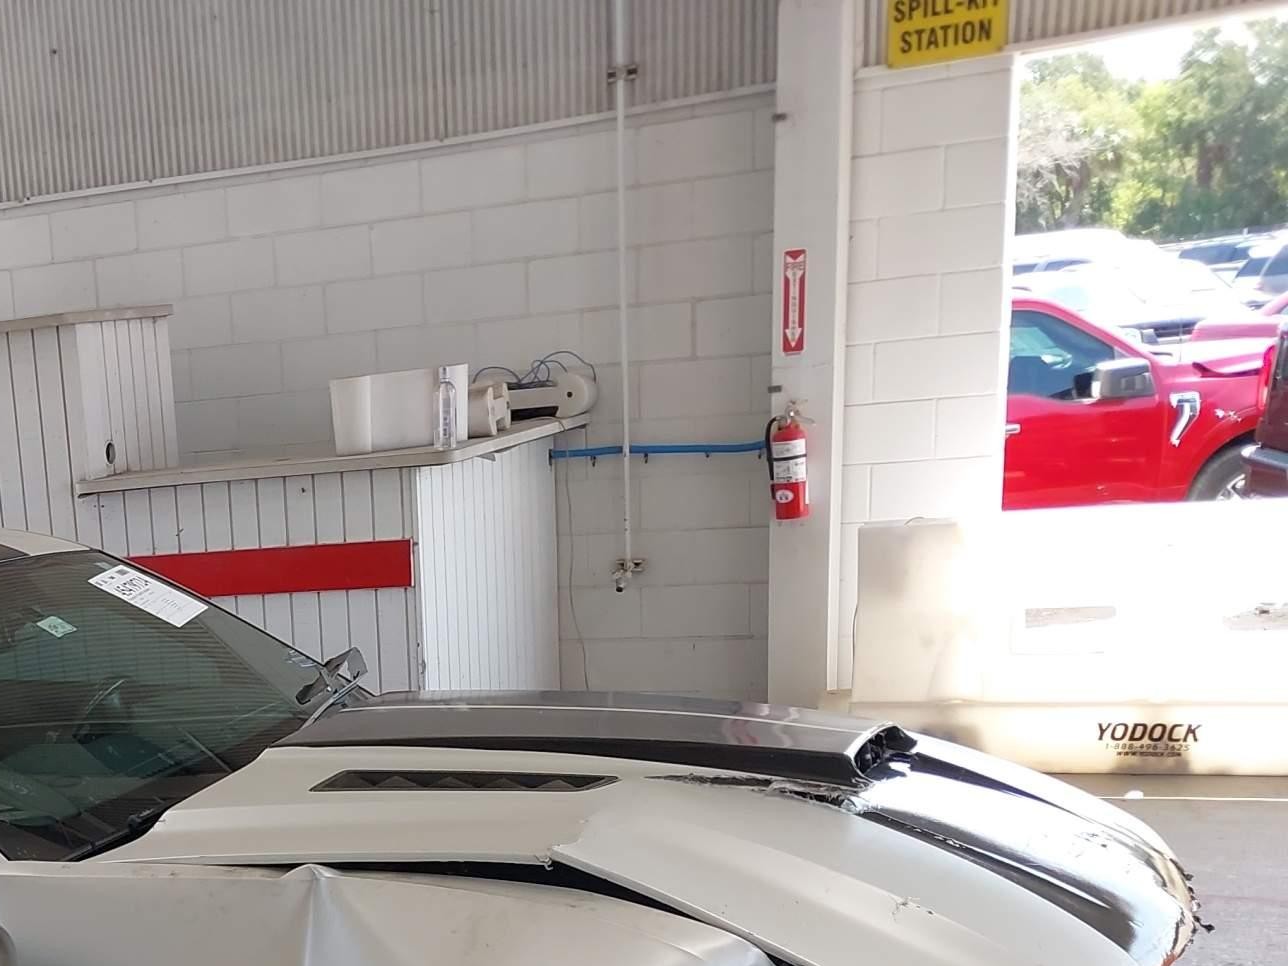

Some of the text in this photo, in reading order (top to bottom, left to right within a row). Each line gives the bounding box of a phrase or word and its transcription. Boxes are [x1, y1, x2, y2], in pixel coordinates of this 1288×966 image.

[894, 0, 999, 22] SPILL-
[900, 18, 992, 53] STATION
[1097, 723, 1202, 742] YODOCK
